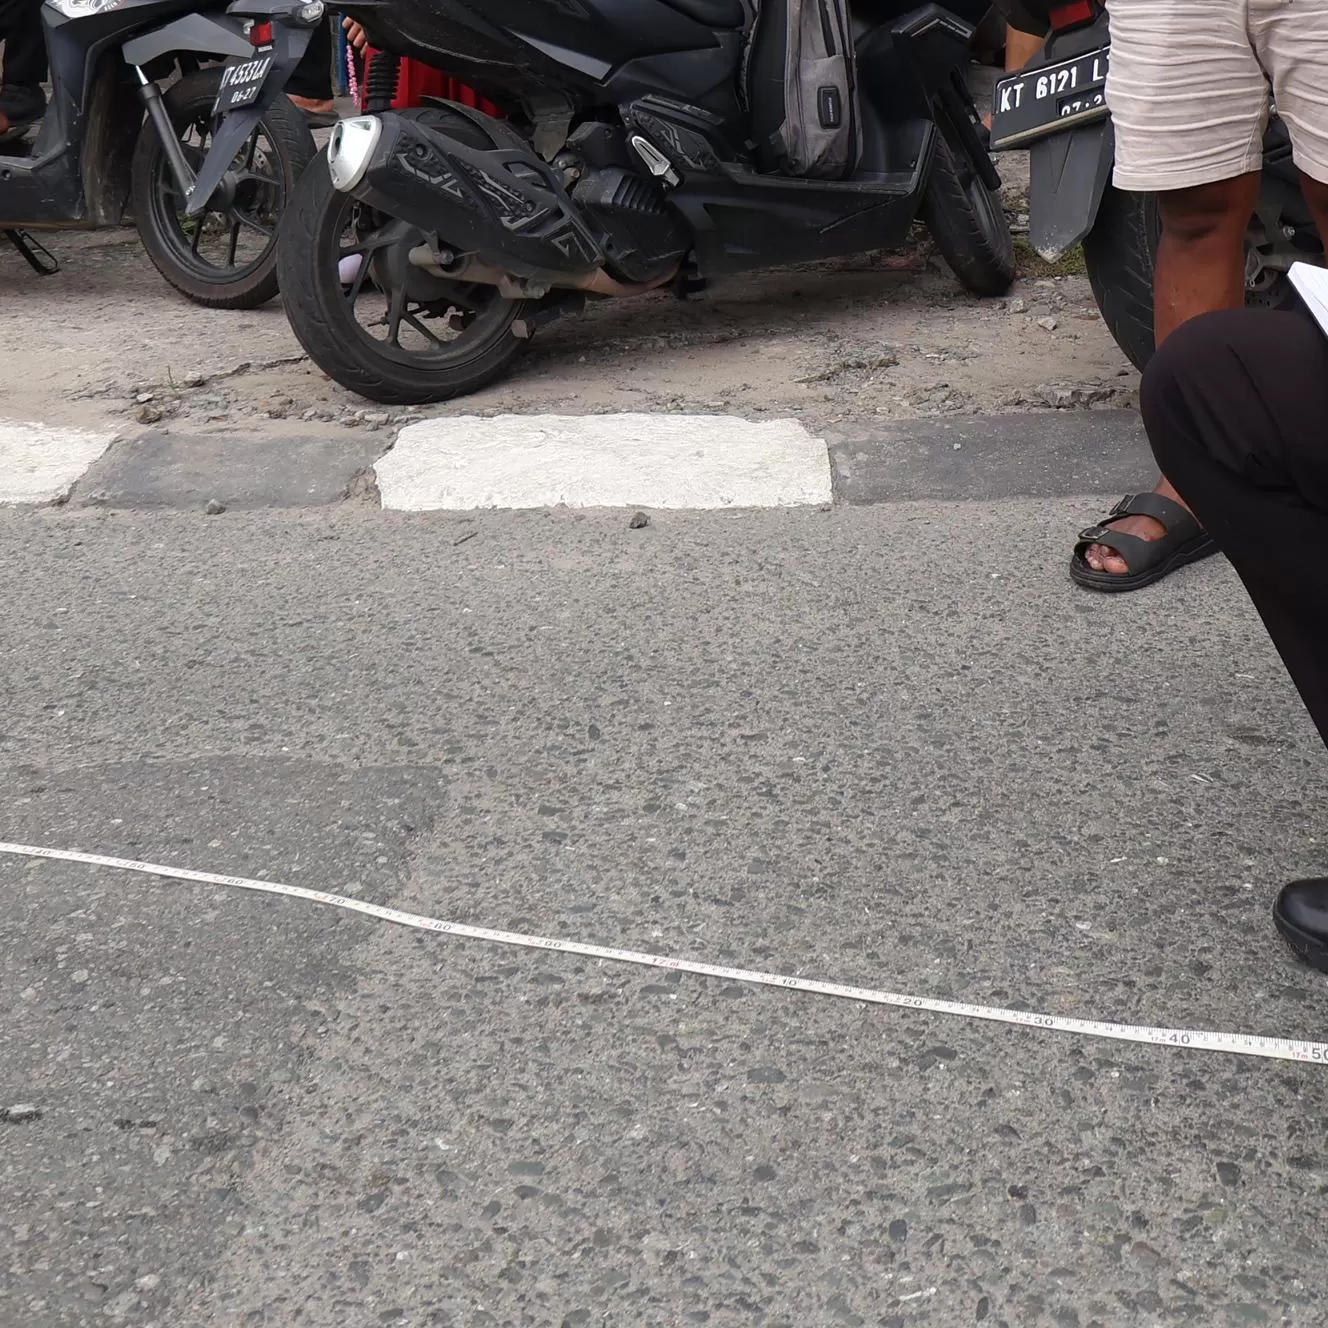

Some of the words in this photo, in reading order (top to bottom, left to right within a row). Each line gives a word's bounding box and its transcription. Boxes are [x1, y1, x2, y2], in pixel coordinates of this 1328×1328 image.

[1001, 82, 1024, 112] KT
[1036, 66, 1077, 99] 6121
[1093, 55, 1110, 81] L
[902, 999, 922, 1007] 20
[1169, 1034, 1190, 1045] 40
